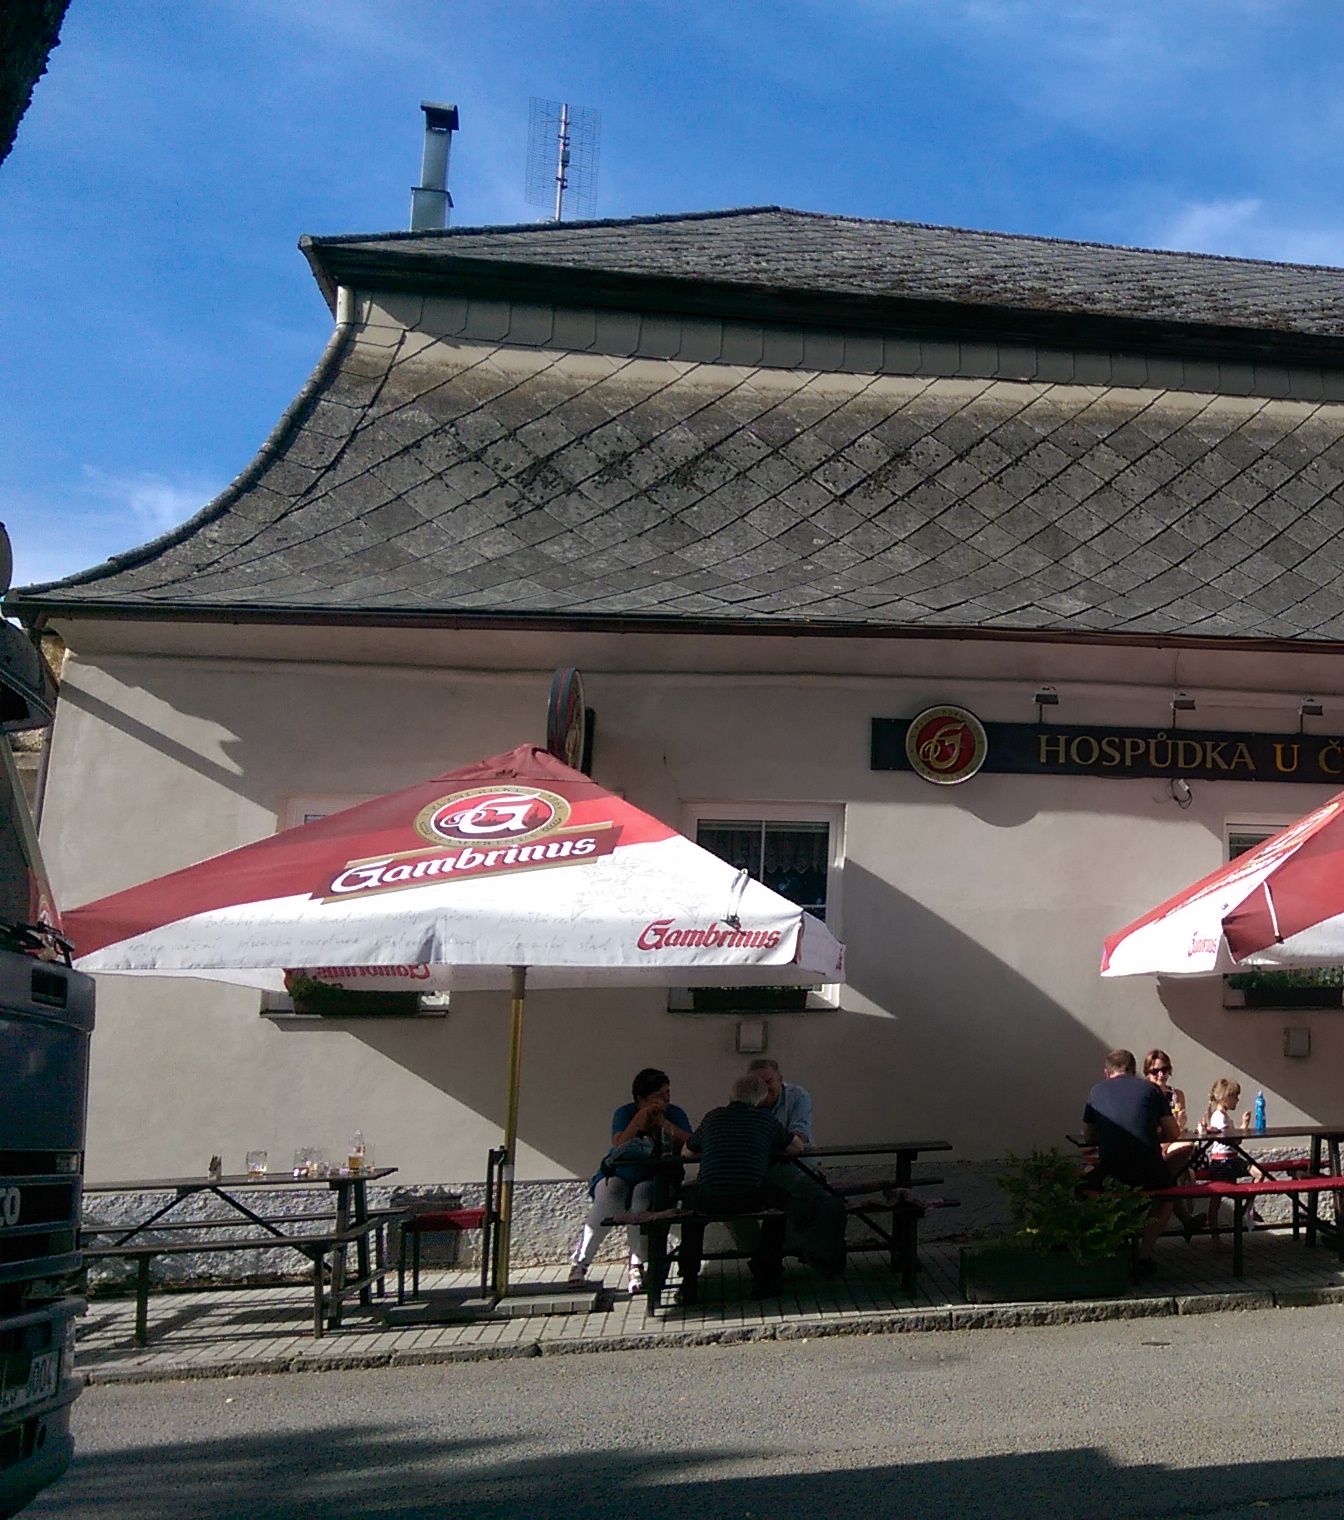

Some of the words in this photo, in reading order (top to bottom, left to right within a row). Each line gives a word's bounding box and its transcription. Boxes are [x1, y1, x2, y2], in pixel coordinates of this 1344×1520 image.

[1037, 732, 1257, 770] HOSPŮDKA
[1272, 743, 1301, 772] U
[330, 837, 596, 894] Gambrinus
[637, 917, 782, 951] Gambrinus
